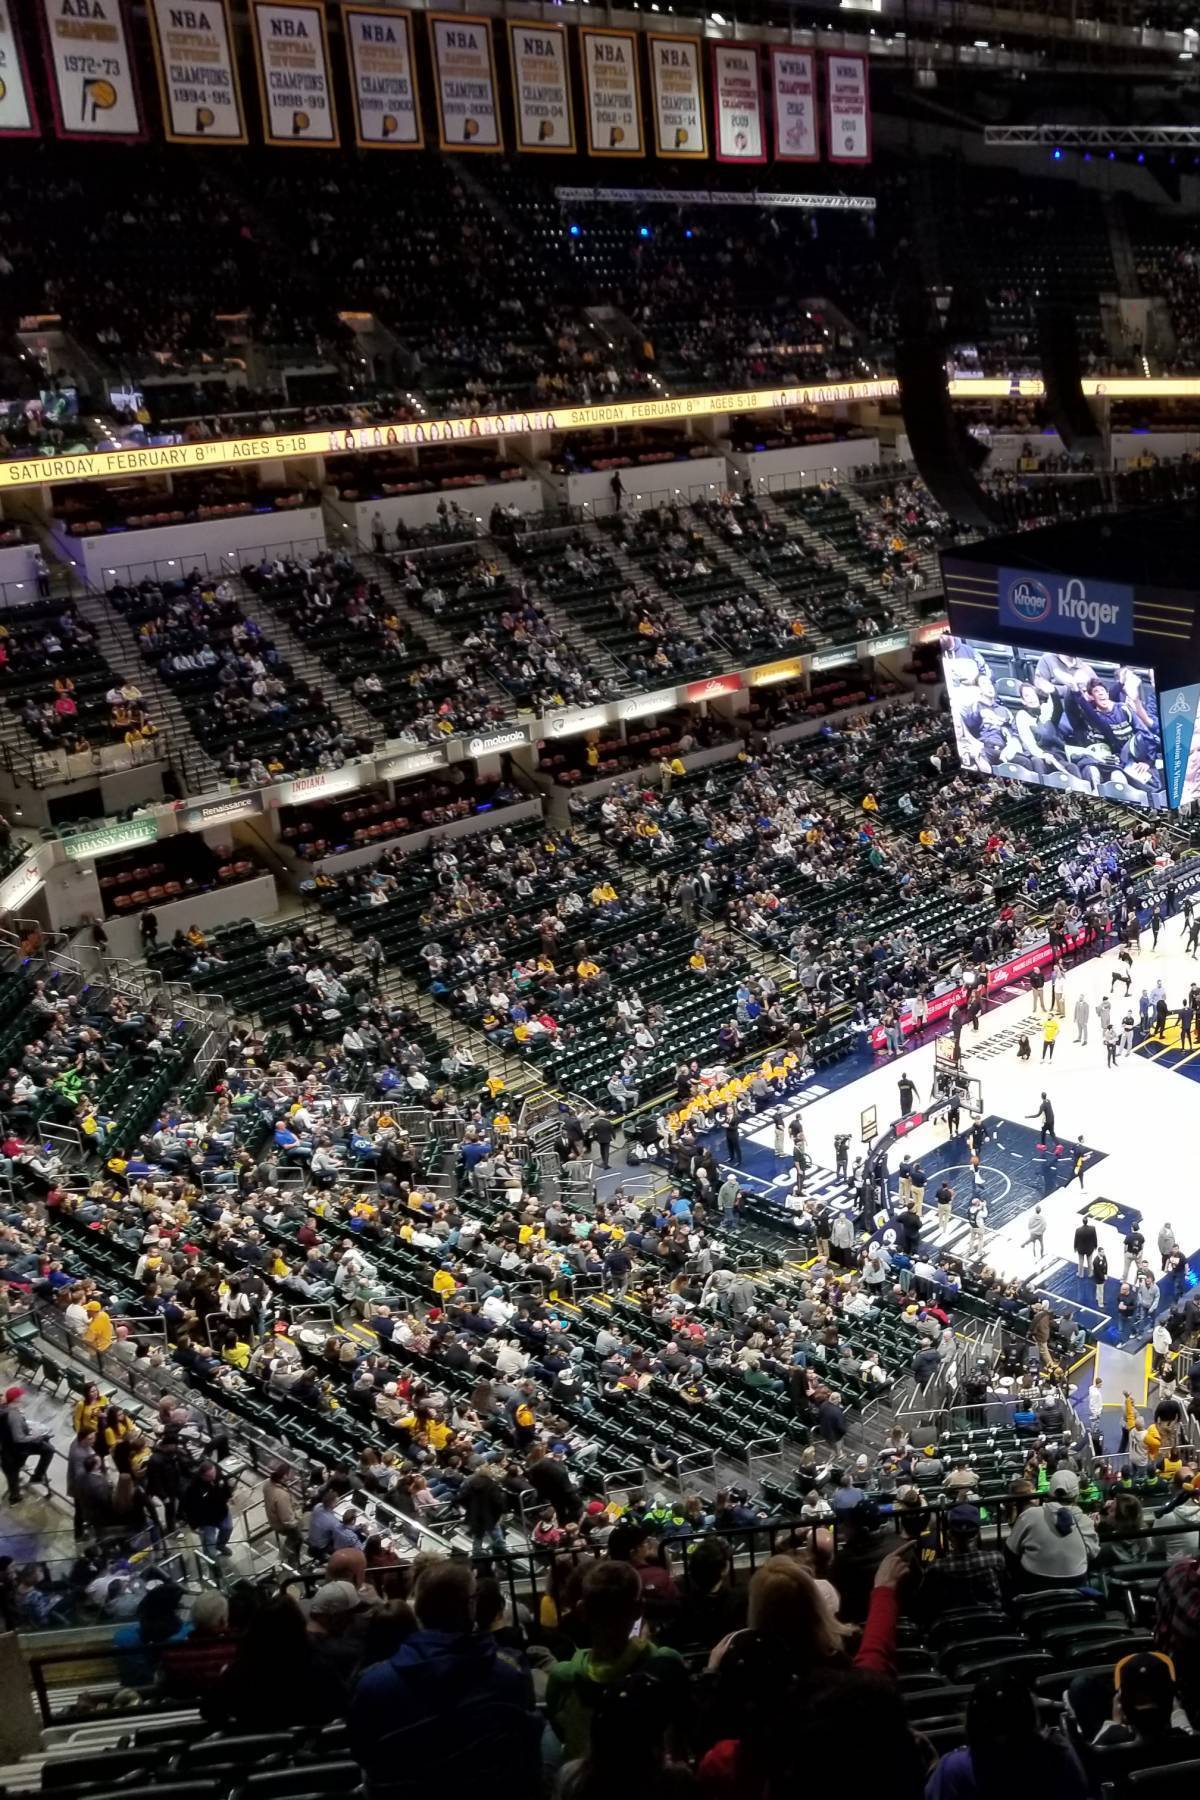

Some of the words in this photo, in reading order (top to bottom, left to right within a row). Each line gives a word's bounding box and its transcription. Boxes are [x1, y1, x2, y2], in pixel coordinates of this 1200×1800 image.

[61, 0, 106, 19] ABA
[169, 9, 211, 30] NBA
[270, 19, 308, 37] NBA
[362, 24, 396, 43] NBA
[447, 31, 478, 49] NBA
[524, 37, 554, 56] NBA
[595, 44, 624, 63] NBA
[660, 49, 690, 67] NBA
[724, 58, 749, 71] WNBA
[170, 65, 229, 86] CHAMPIONS
[780, 60, 807, 76] WNBA
[836, 66, 857, 78] WNBA
[269, 72, 323, 91] CHAMPIONS
[360, 77, 408, 95] CHAMPIONS
[444, 82, 488, 100] CHAMPIONS
[522, 85, 563, 102] CHAMPIONS
[594, 92, 632, 109] CHAMPIONS
[661, 95, 696, 111] CHAMPIONS
[570, 408, 628, 424] SATURDAY,
[631, 402, 683, 418] FEBRUARY
[709, 397, 734, 410] AGES
[737, 395, 758, 408] 5-18
[9, 459, 102, 481] SATURDAY,
[107, 448, 188, 471] FEBRUARY
[232, 441, 271, 458] AGES
[275, 437, 307, 453] 5-18
[1014, 584, 1046, 616] Kroger
[1058, 578, 1120, 638] Kroger
[484, 730, 525, 747] motorola
[291, 775, 327, 793] INDIANA
[202, 798, 253, 818] Renaissance
[65, 835, 116, 856] EMBASSY
[118, 825, 158, 842] SUITES
[960, 1029, 1015, 1060] BANKERS
[1012, 1015, 1041, 1030] LIFE
